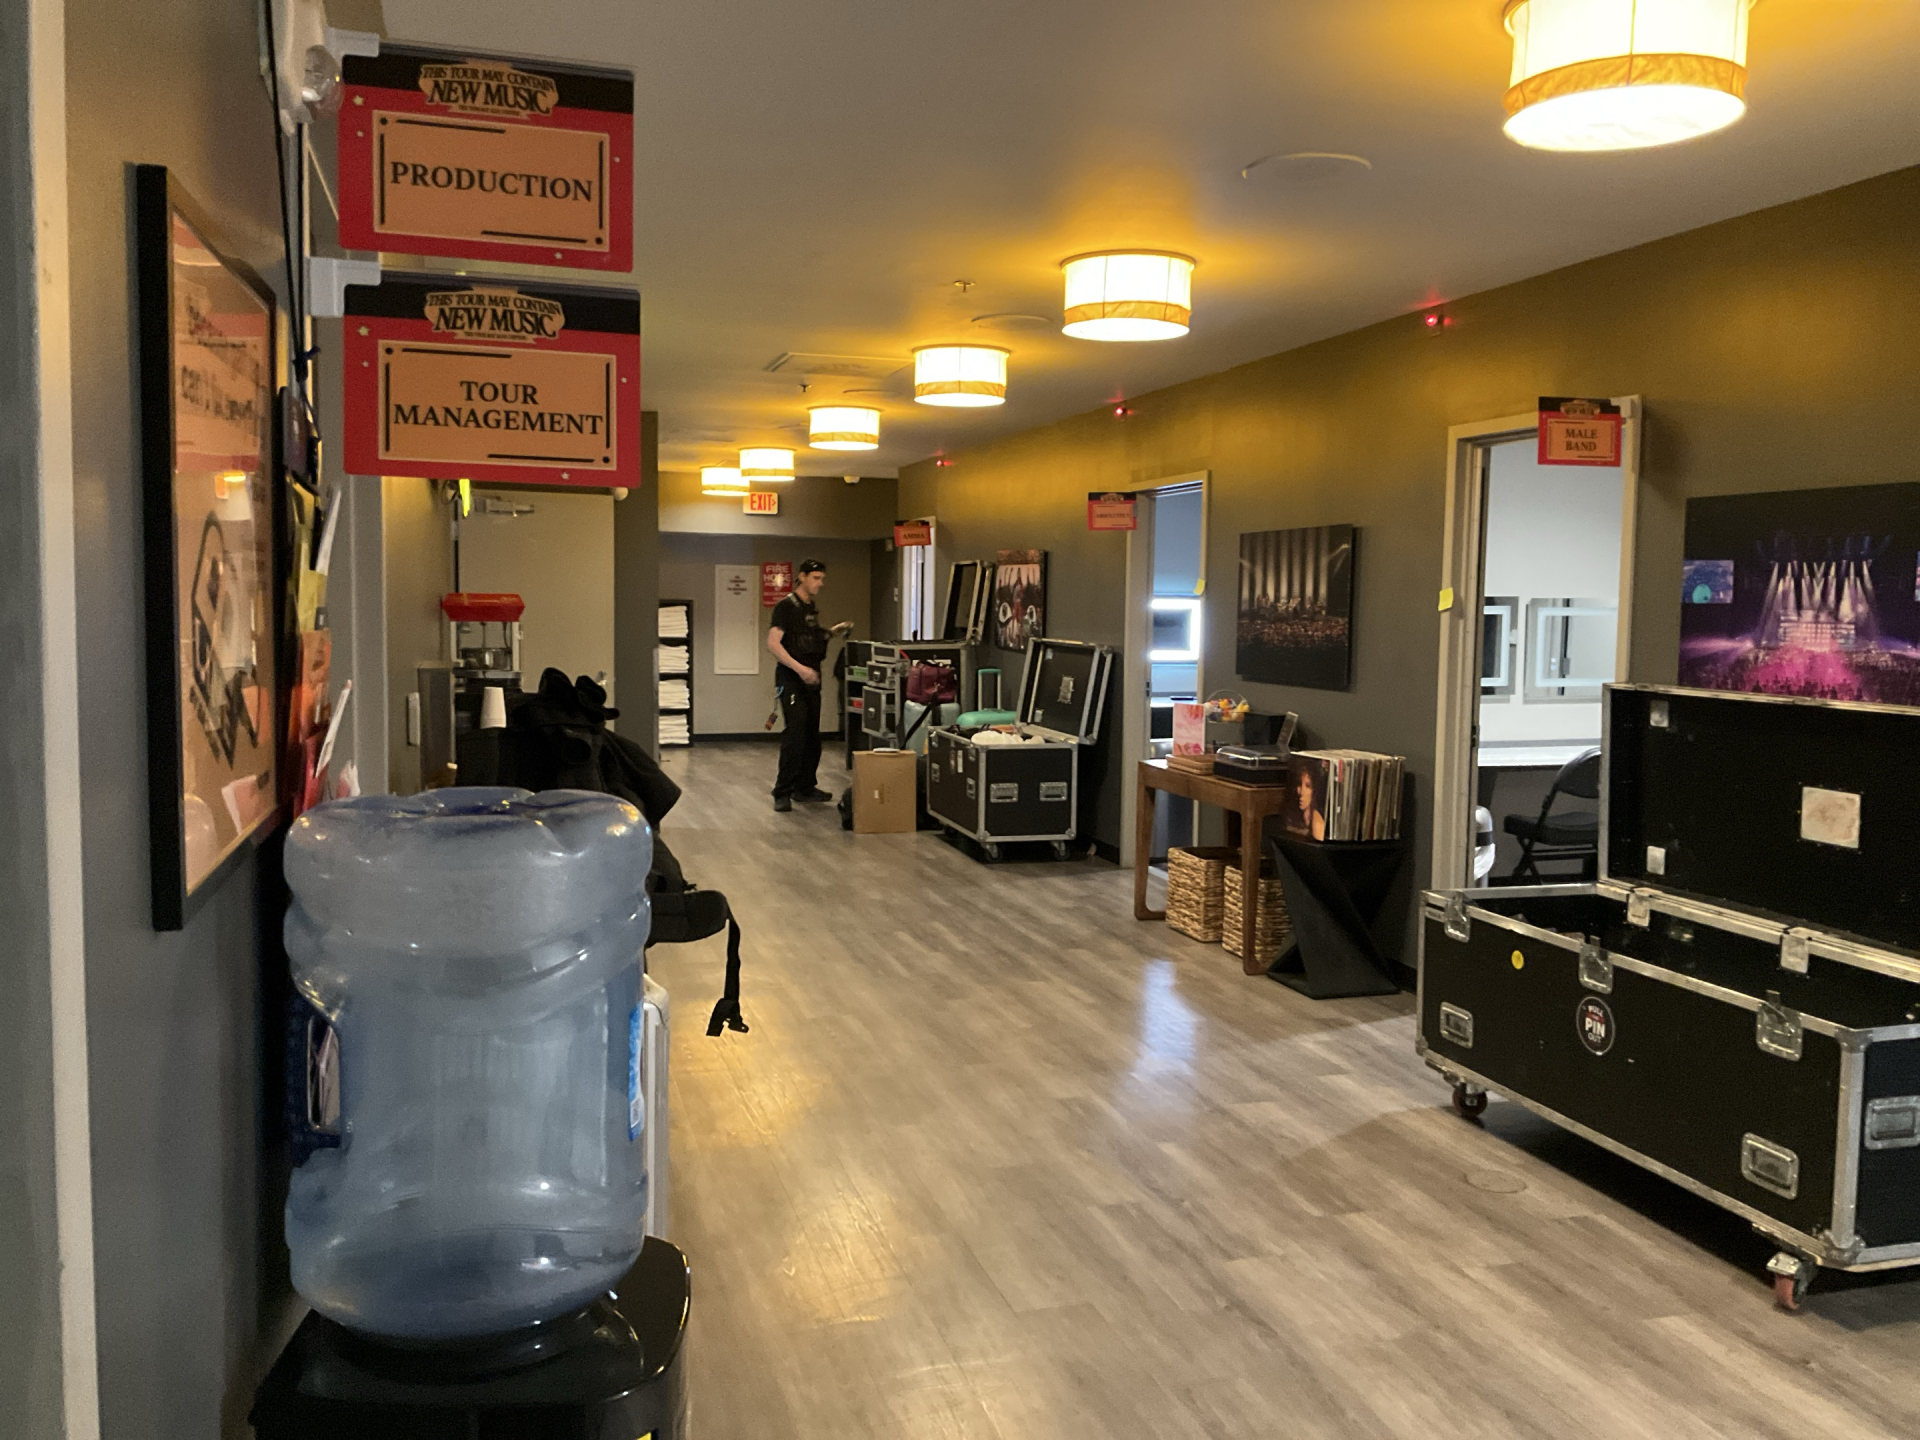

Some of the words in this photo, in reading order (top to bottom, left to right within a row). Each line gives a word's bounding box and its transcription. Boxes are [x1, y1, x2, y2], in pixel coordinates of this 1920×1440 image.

[424, 66, 447, 79] THIS
[451, 67, 479, 80] TOUR
[482, 69, 504, 82] MAY
[507, 72, 554, 92] CONTAIN
[428, 80, 482, 104] NEW
[484, 82, 550, 114] MUSIC
[390, 161, 592, 202] PRODUCTION
[428, 294, 452, 306] THIS
[456, 294, 485, 306] TOUR
[488, 295, 511, 308] MAY
[513, 297, 560, 315] CONTAIN
[434, 307, 488, 331] NEW
[490, 308, 556, 337] MUSIC
[459, 380, 539, 405] TOUR
[393, 403, 603, 435] MANAGEMENT
[1565, 428, 1597, 439] MALE
[1565, 440, 1597, 451] BAND
[750, 493, 773, 511] EXIT
[765, 564, 789, 574] FIRE
[1585, 1017, 1605, 1038] PIN
